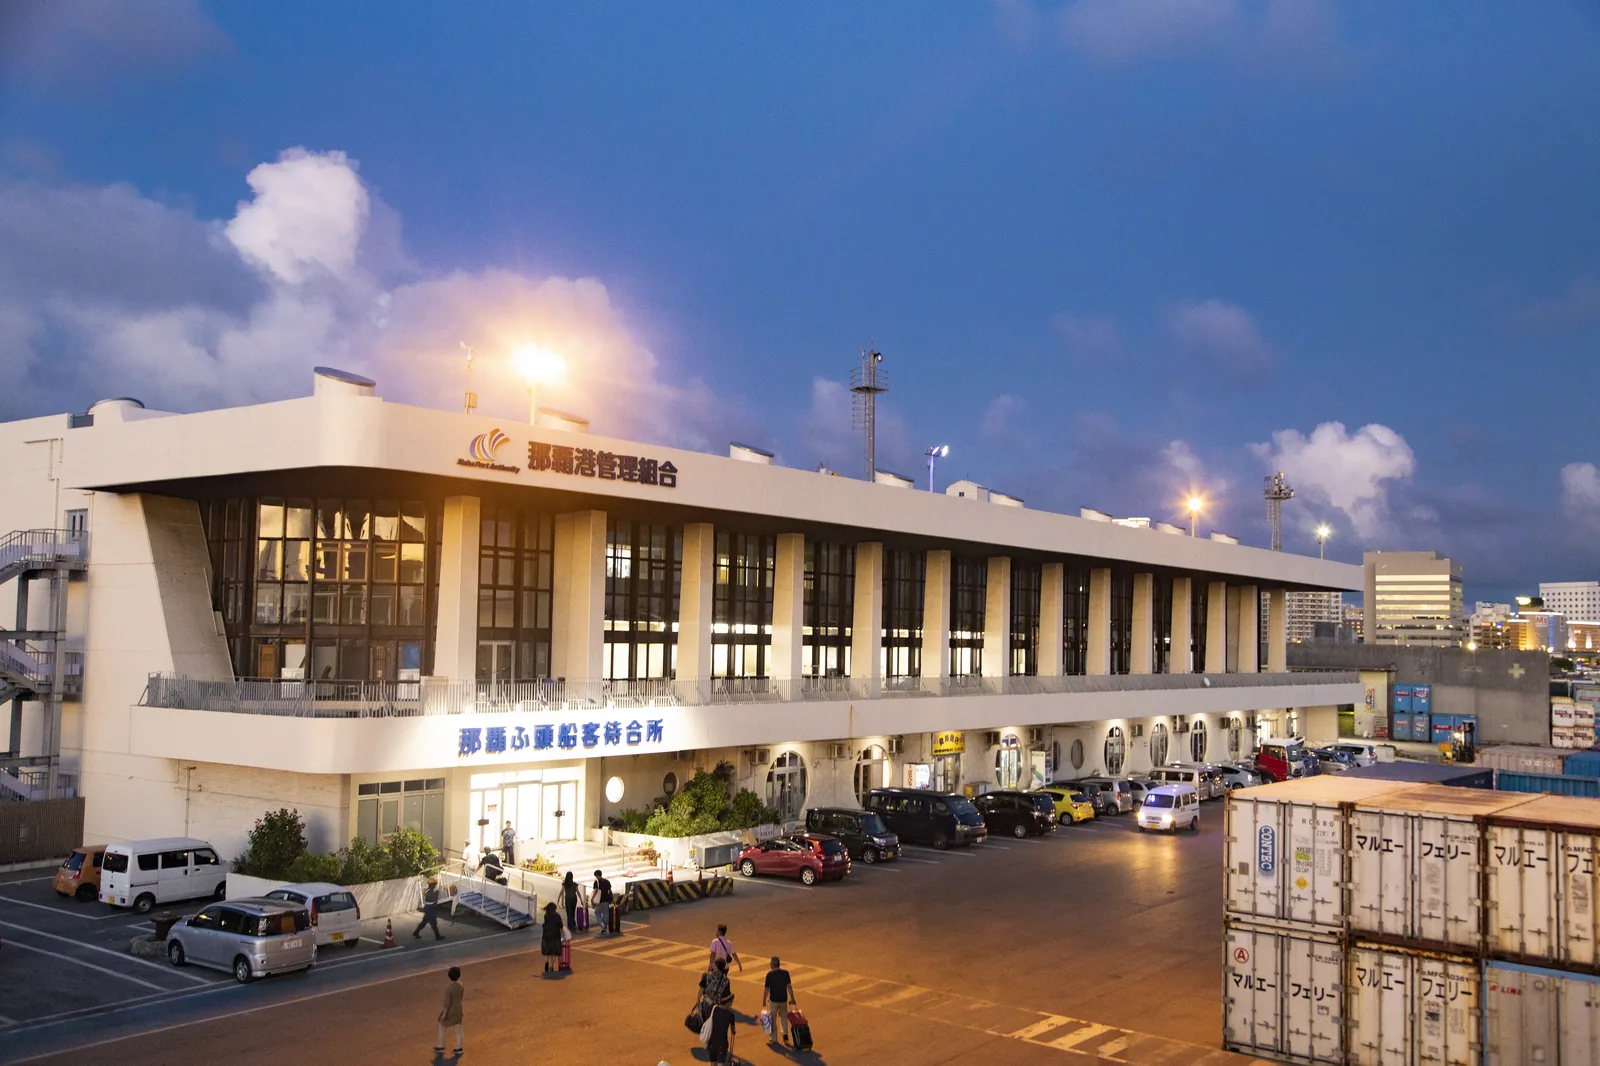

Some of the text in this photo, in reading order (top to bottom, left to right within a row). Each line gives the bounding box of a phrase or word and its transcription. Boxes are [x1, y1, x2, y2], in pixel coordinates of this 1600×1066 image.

[527, 440, 678, 488] 那覇港管理組合
[458, 718, 664, 756] 那覇ふ頭船客待合所
[1260, 826, 1273, 871] CONTEC
[1356, 835, 1471, 860] マルエー フェリー
[1494, 846, 1549, 869] マルエー
[1232, 973, 1336, 1001] マルエー フェリー
[1356, 967, 1473, 1001] マルエー フェリー
